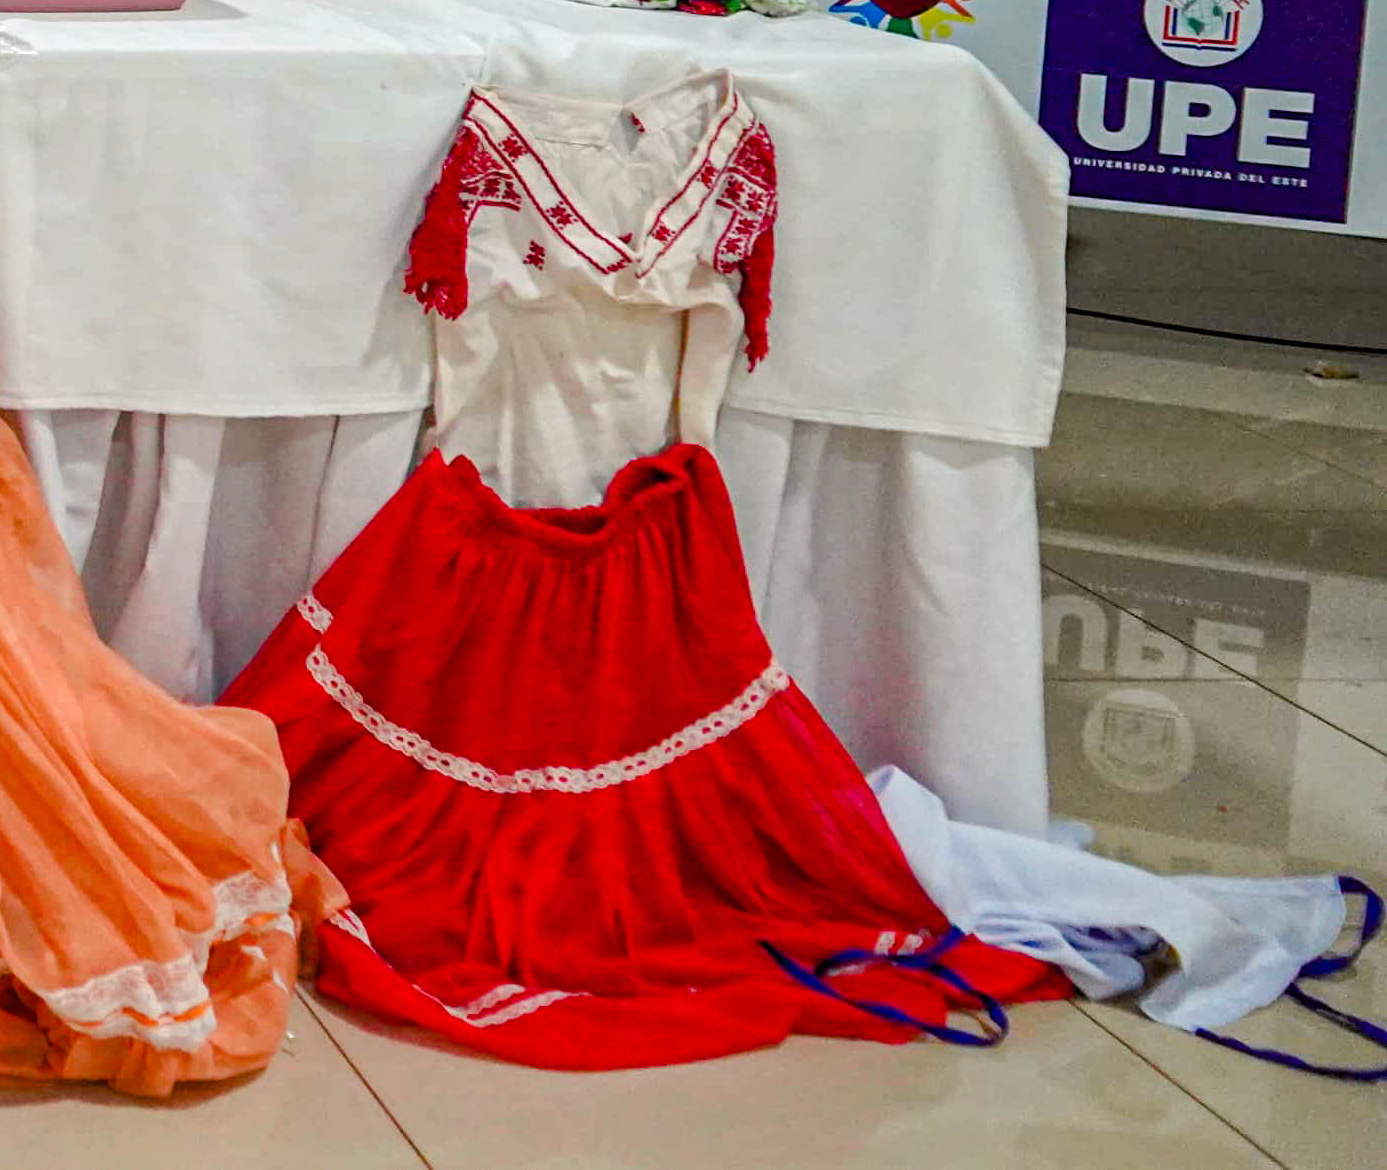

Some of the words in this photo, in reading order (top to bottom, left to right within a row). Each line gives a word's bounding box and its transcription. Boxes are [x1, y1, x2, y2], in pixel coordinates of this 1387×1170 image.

[1077, 73, 1315, 169] UPE
[1073, 157, 1166, 174] UNIVERSIDAD
[1172, 166, 1232, 180] PRIVADA
[1238, 173, 1265, 184] DEL
[1272, 176, 1308, 188] ESTE
